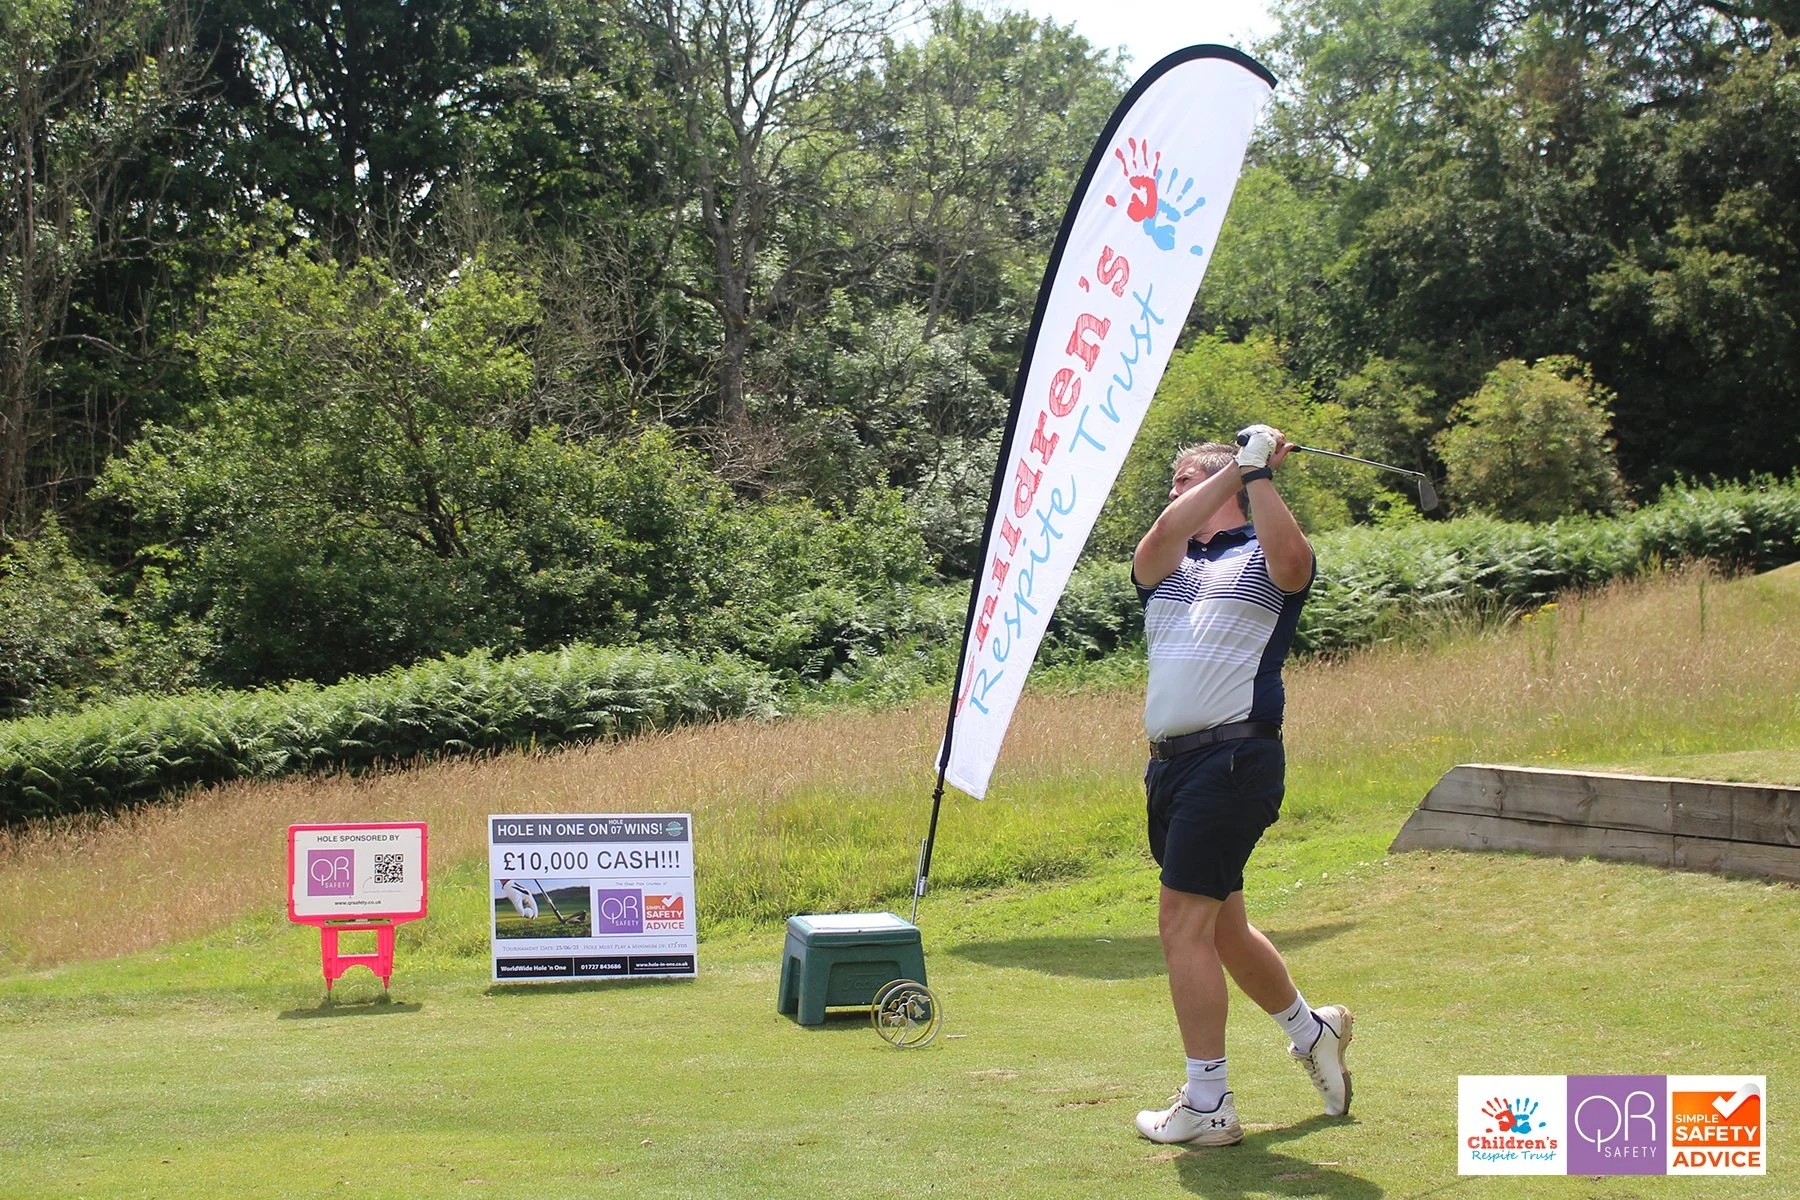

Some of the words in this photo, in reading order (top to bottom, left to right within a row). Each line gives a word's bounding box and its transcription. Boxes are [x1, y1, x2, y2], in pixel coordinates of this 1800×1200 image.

[969, 474, 1076, 714] Respite
[1069, 283, 1164, 452] Trust
[317, 835, 338, 843] HOLE
[340, 834, 388, 842] SPONSORED
[498, 824, 534, 837] HOLE
[538, 824, 552, 836] IN
[556, 823, 585, 836] ONE
[588, 823, 608, 836] ON
[610, 826, 622, 835] 07
[624, 823, 663, 835] WINS!
[503, 851, 589, 873] £10,000
[597, 850, 681, 870] CASH!!!
[311, 856, 350, 886] QR
[601, 895, 638, 924] QR
[646, 910, 683, 918] SAFETY
[646, 921, 685, 930] ADVICE
